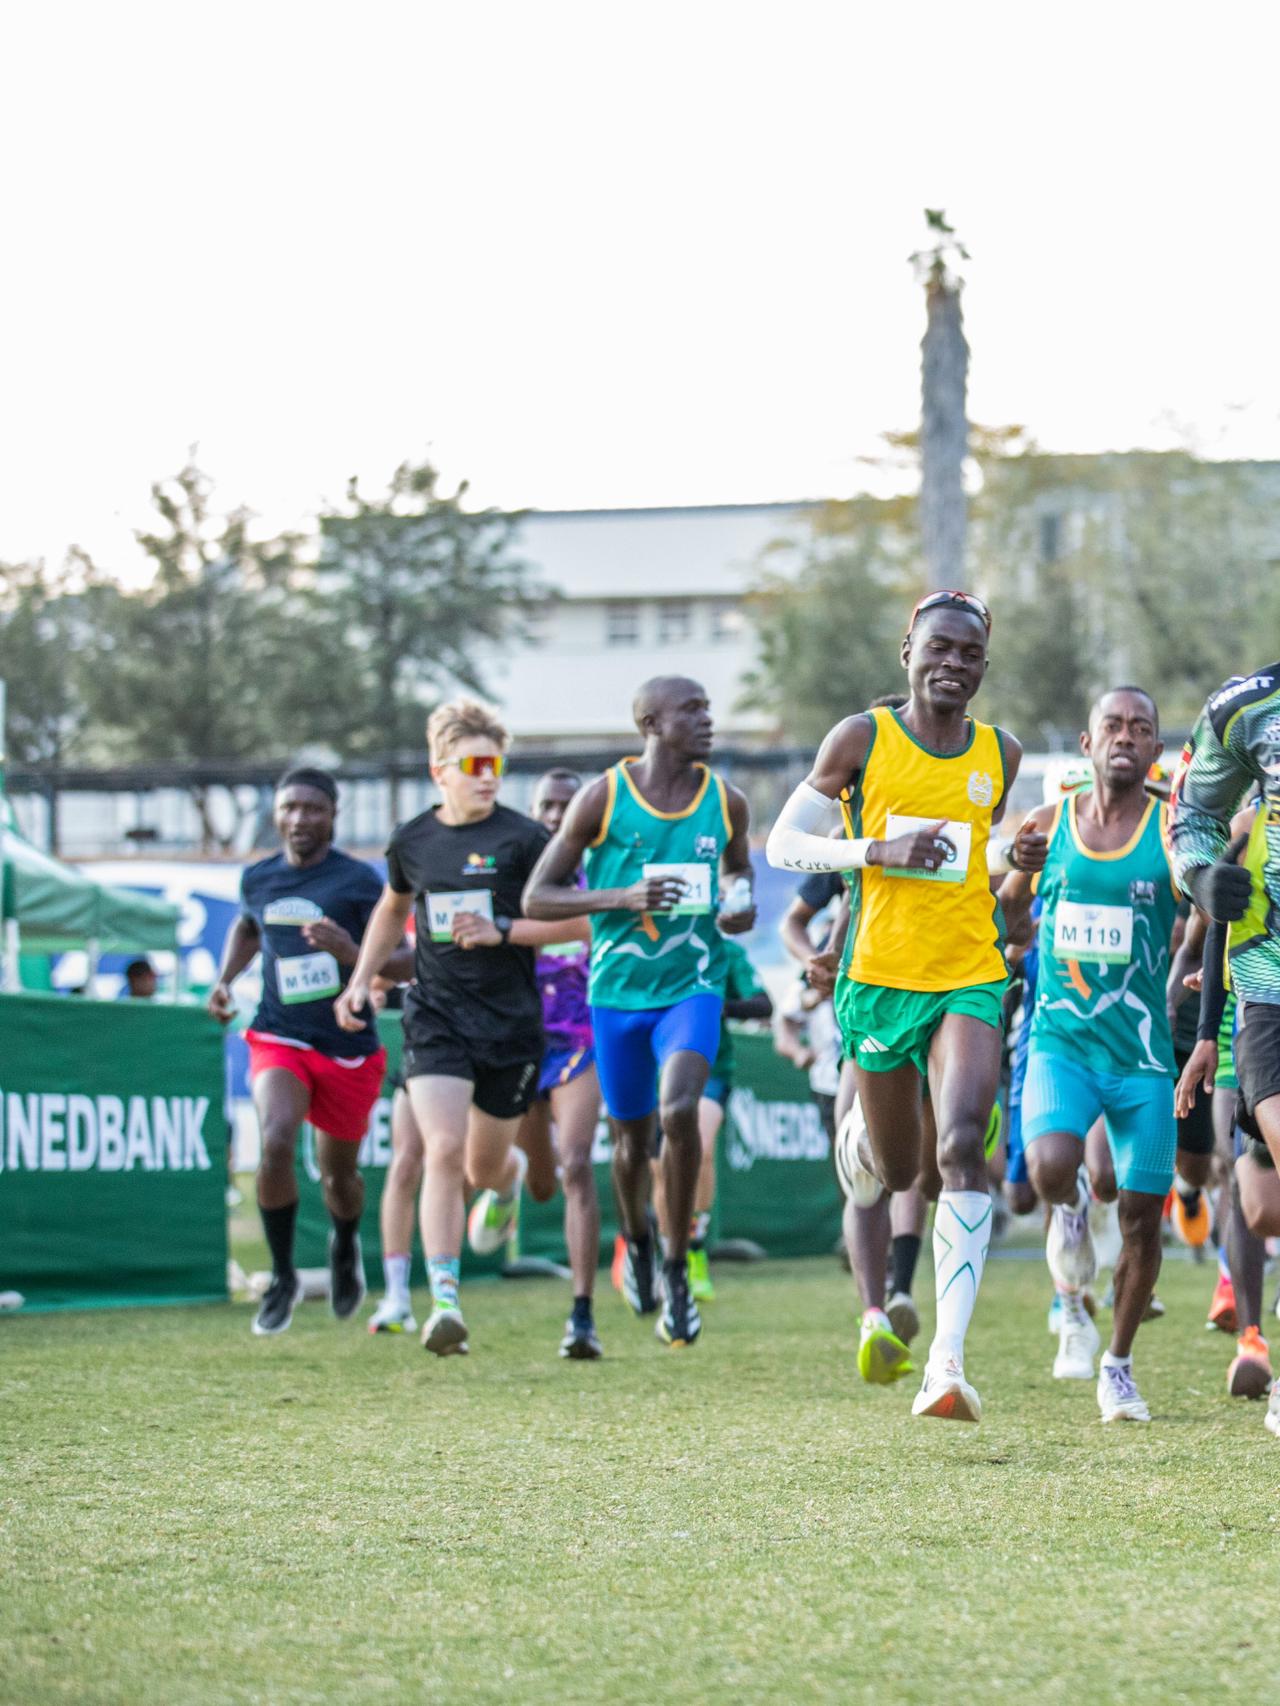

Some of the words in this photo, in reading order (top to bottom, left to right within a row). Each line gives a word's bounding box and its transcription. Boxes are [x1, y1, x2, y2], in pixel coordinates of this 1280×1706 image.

[783, 858, 832, 870] FALKE
[436, 912, 449, 926] M
[1061, 925, 1077, 943] M
[1083, 927, 1122, 947] 119
[285, 976, 298, 989] M
[7, 1091, 212, 1172] NEDBANK
[756, 1101, 830, 1161] NEDB
